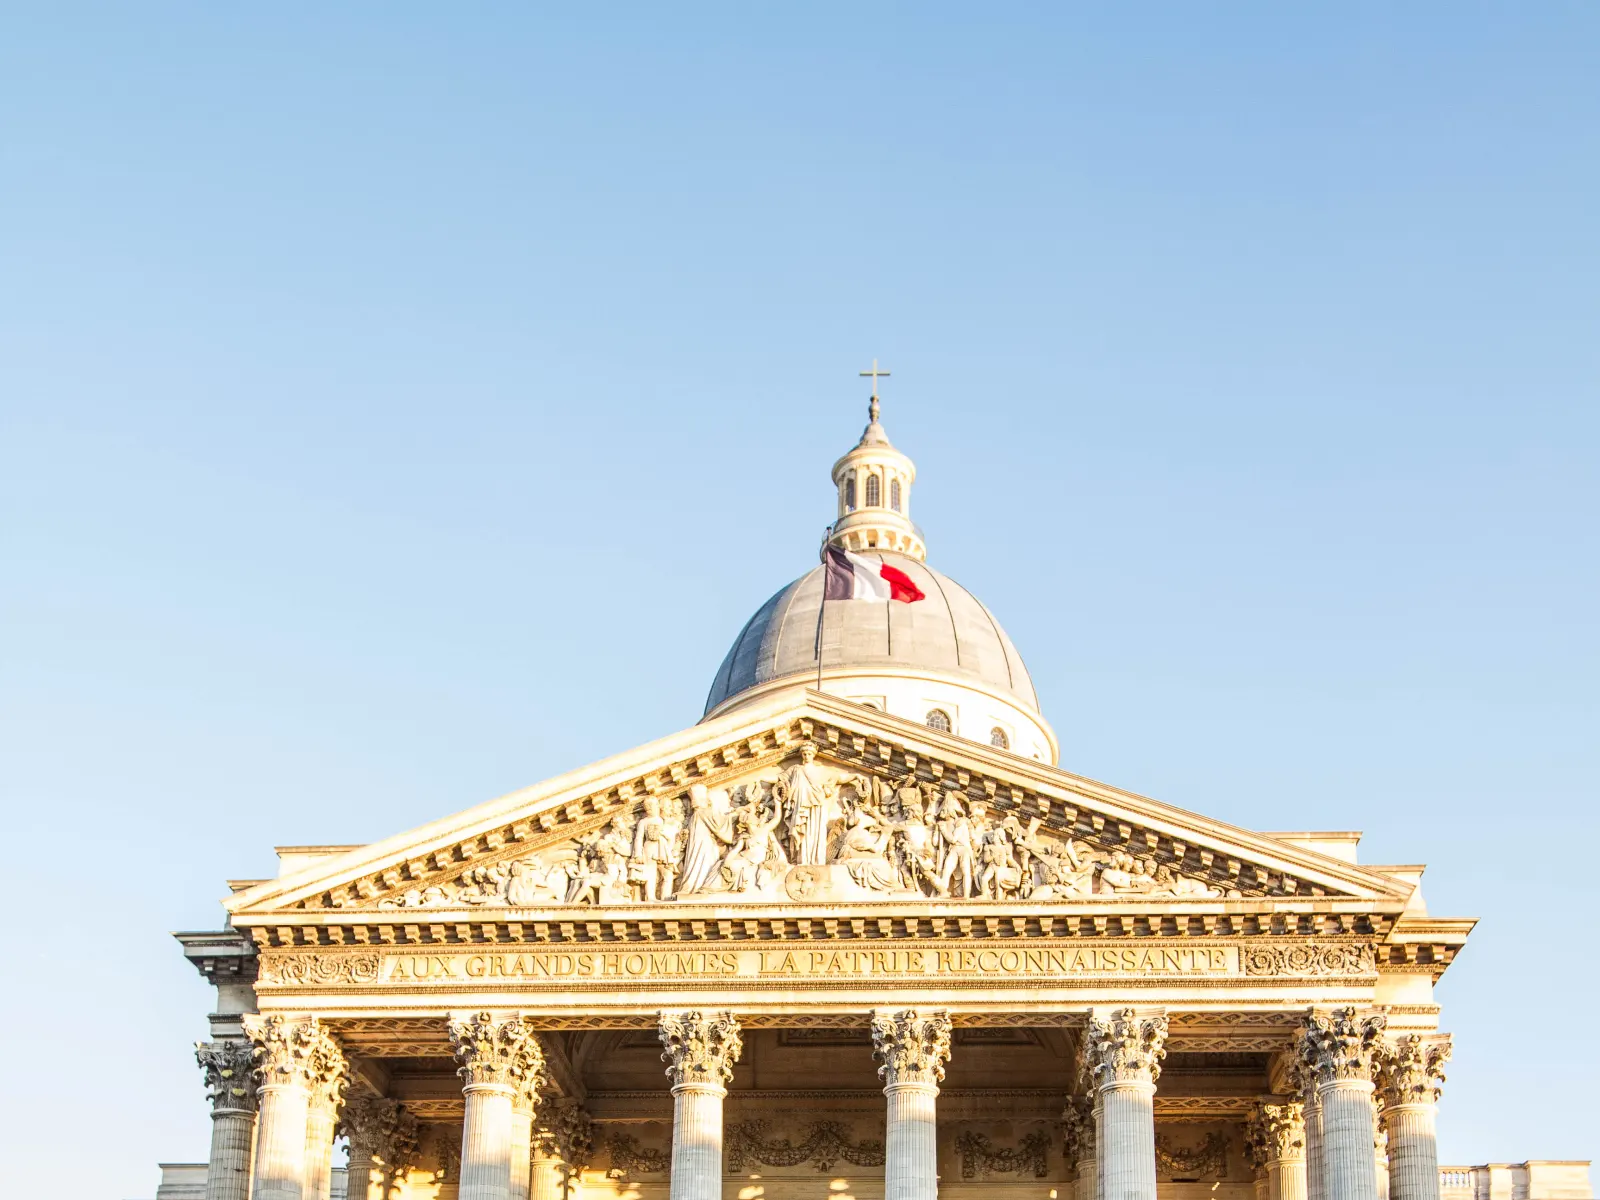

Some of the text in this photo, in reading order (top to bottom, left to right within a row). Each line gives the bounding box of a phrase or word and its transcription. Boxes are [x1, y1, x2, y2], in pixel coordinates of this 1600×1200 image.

[389, 949, 1228, 978] AUX GRANDS HOMMES LA PATRIE RECONNAISSANTE
